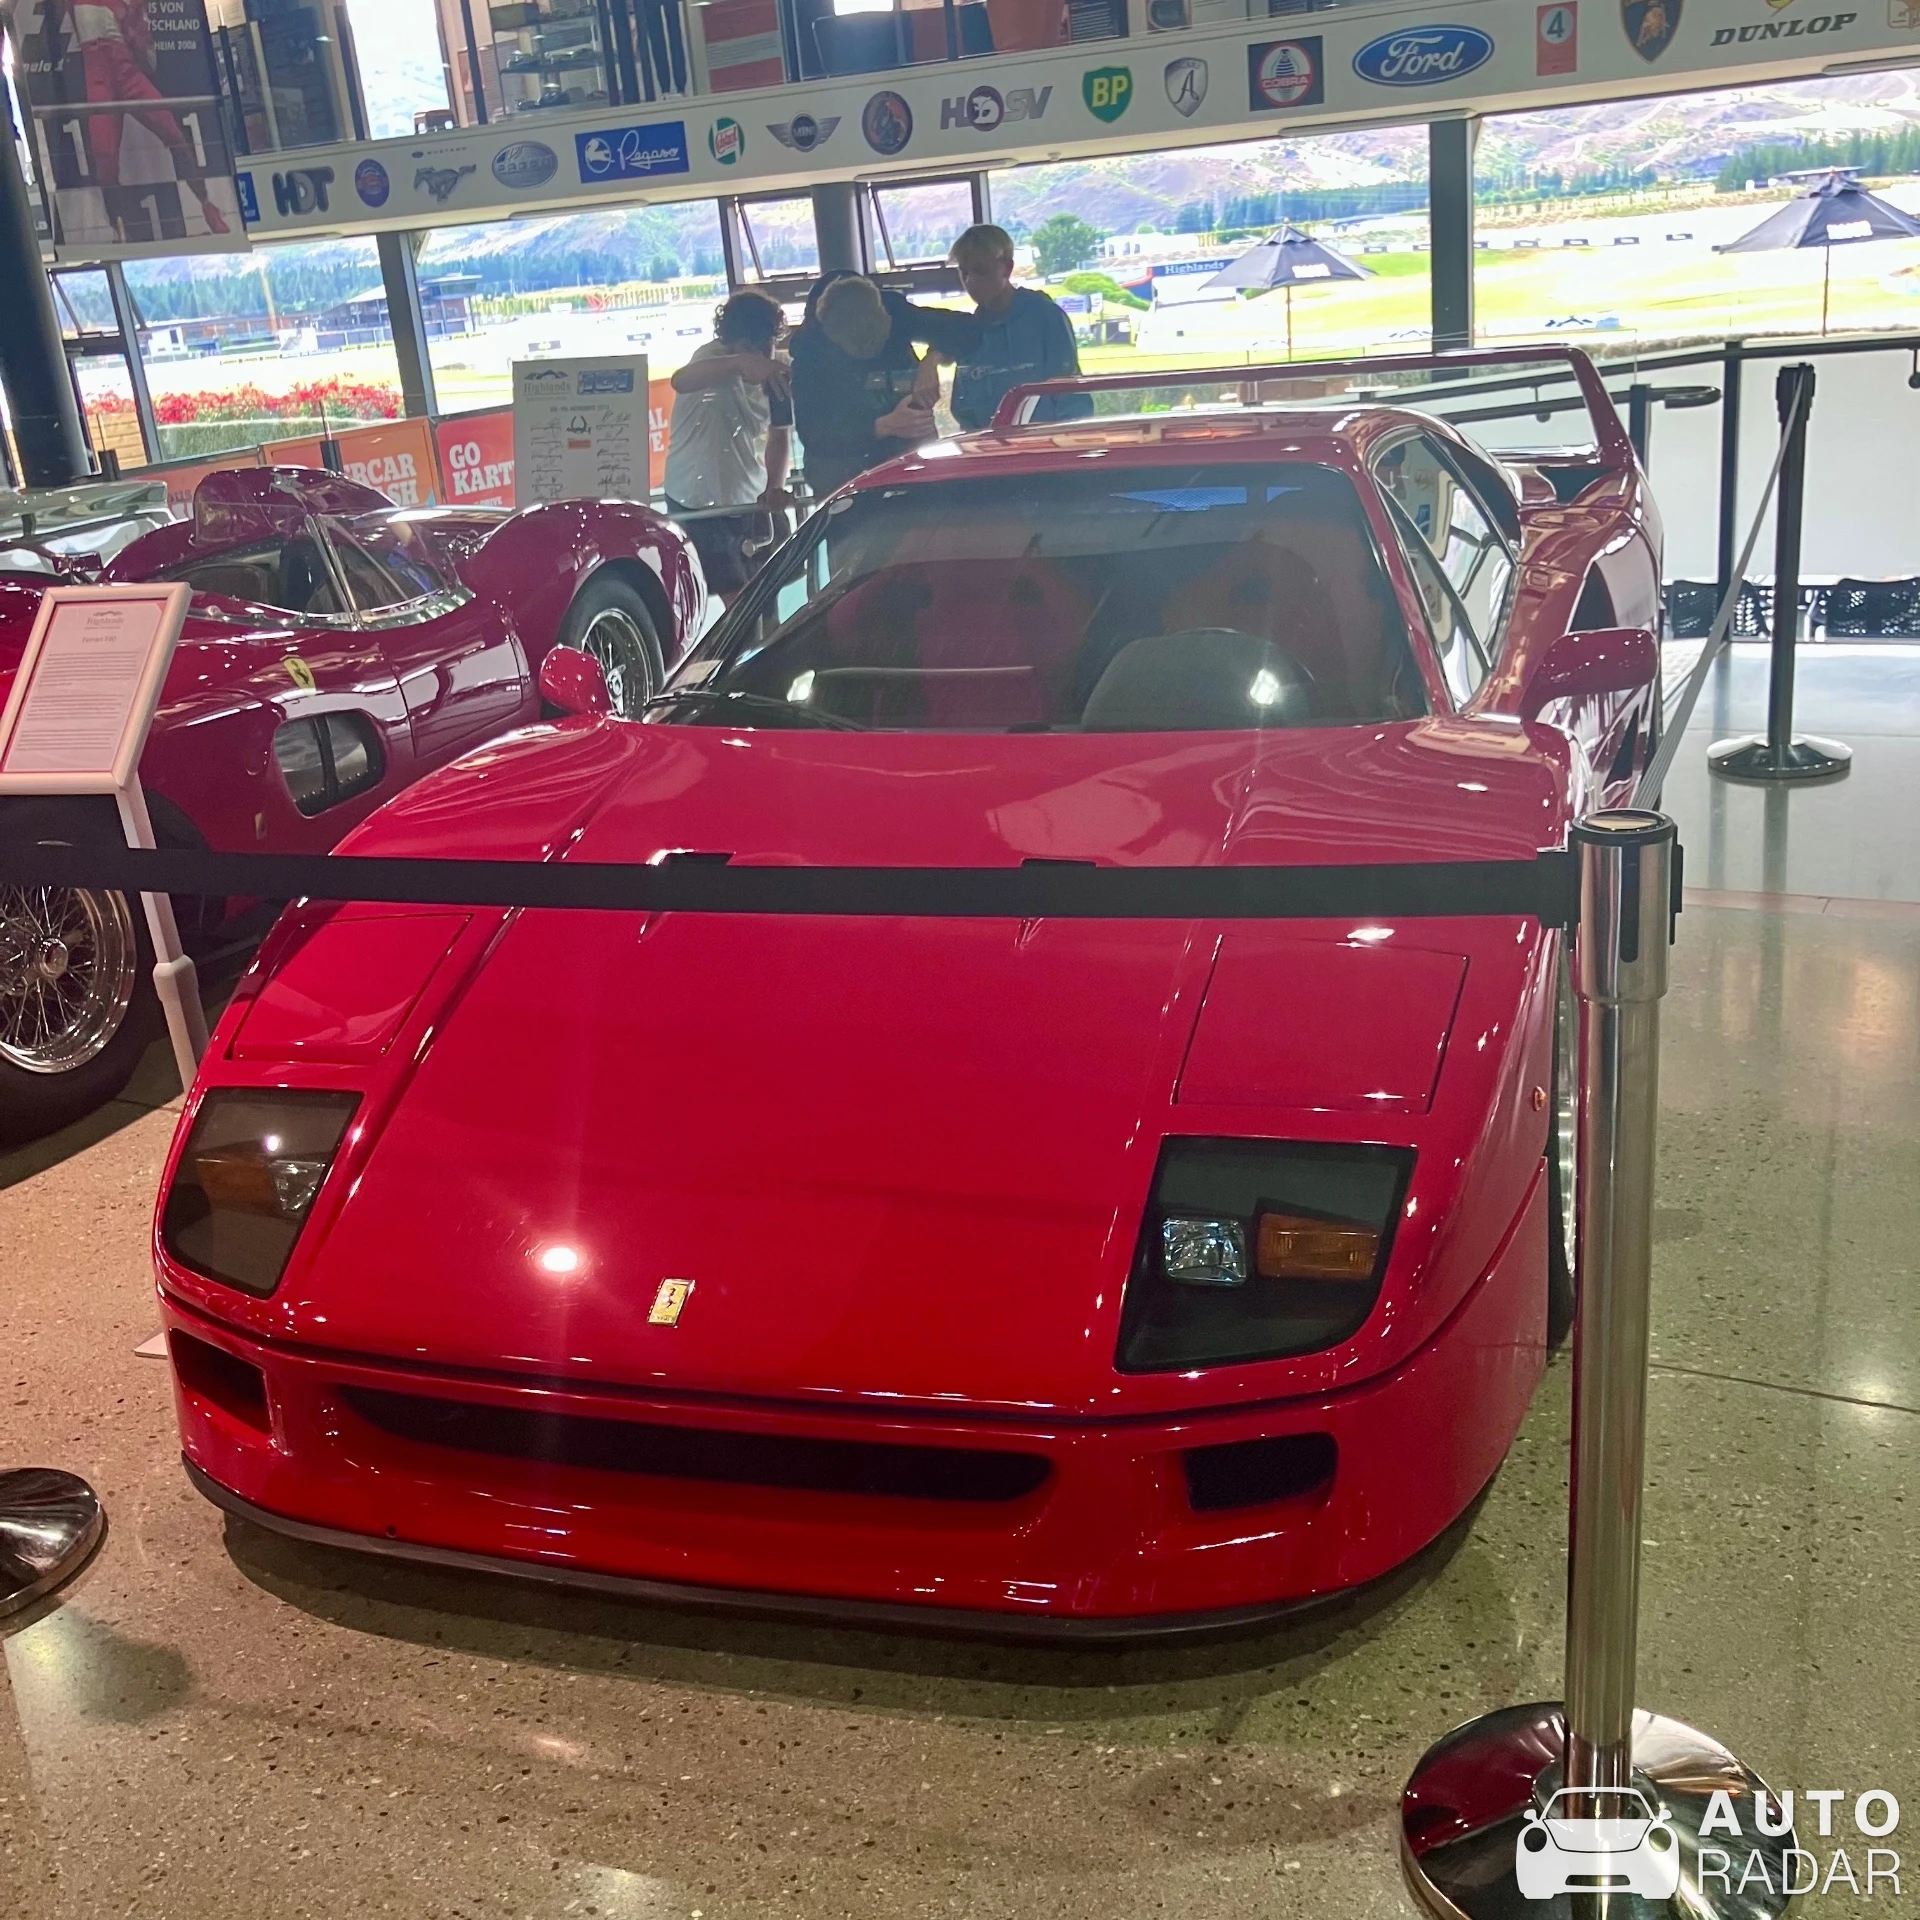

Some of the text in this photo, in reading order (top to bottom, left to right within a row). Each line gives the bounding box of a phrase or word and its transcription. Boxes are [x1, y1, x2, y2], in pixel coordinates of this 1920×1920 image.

[160, 2, 184, 13] VON
[1547, 10, 1566, 38] 4
[1710, 13, 1857, 46] DUNLOP
[1380, 35, 1465, 78] Ford
[1092, 75, 1129, 107] BP
[1262, 75, 1310, 90] COBRA
[63, 119, 89, 176] 1
[183, 112, 207, 167] 1
[617, 129, 680, 171] Pegaso
[272, 166, 335, 217] HDT
[141, 194, 163, 241] 1
[1165, 261, 1225, 275] Highlands
[449, 441, 481, 470] GO
[452, 460, 515, 496] KART
